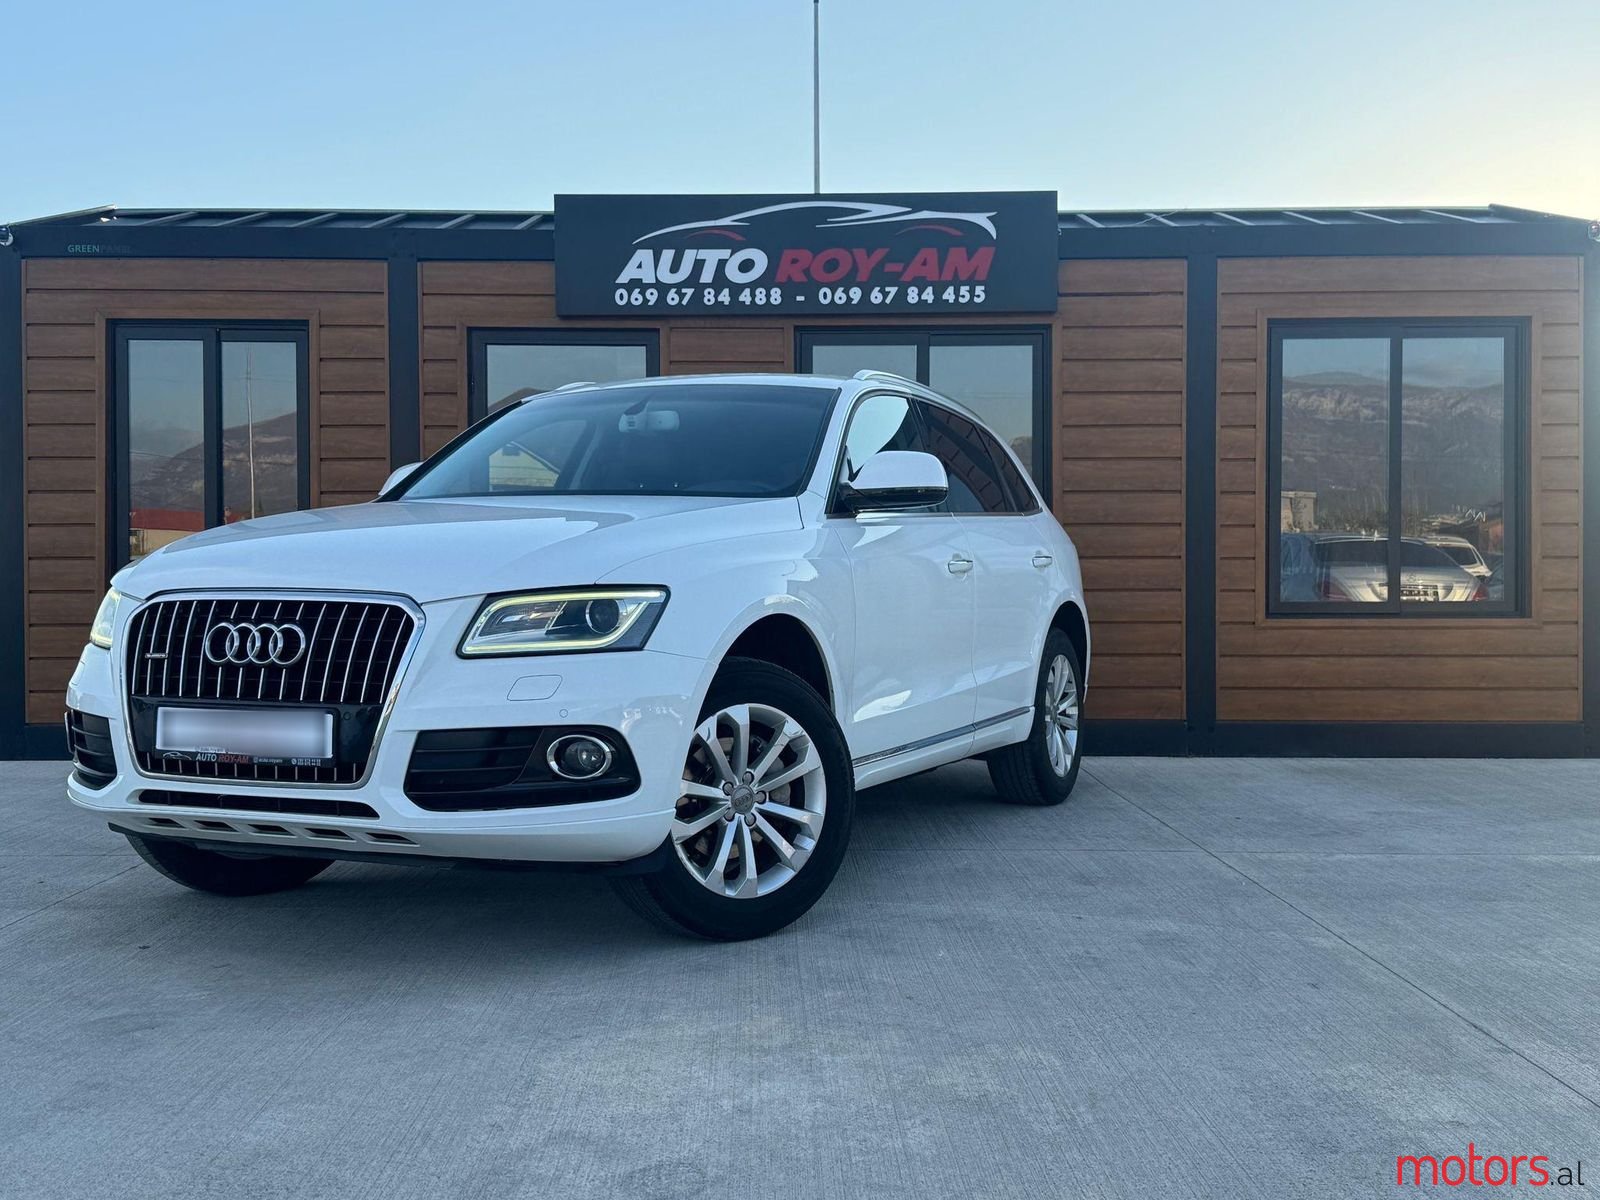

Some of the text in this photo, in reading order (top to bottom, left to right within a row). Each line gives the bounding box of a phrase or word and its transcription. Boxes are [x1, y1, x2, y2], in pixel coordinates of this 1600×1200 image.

[615, 247, 996, 284] AUTO ROY-AM
[614, 288, 658, 306] 069
[666, 288, 695, 306] 67
[703, 287, 731, 305] 84
[738, 287, 782, 305] 488
[818, 287, 862, 305] 069
[870, 286, 898, 304] 67
[906, 286, 934, 304] 84
[942, 285, 986, 303] 455
[196, 753, 217, 762] AUTO
